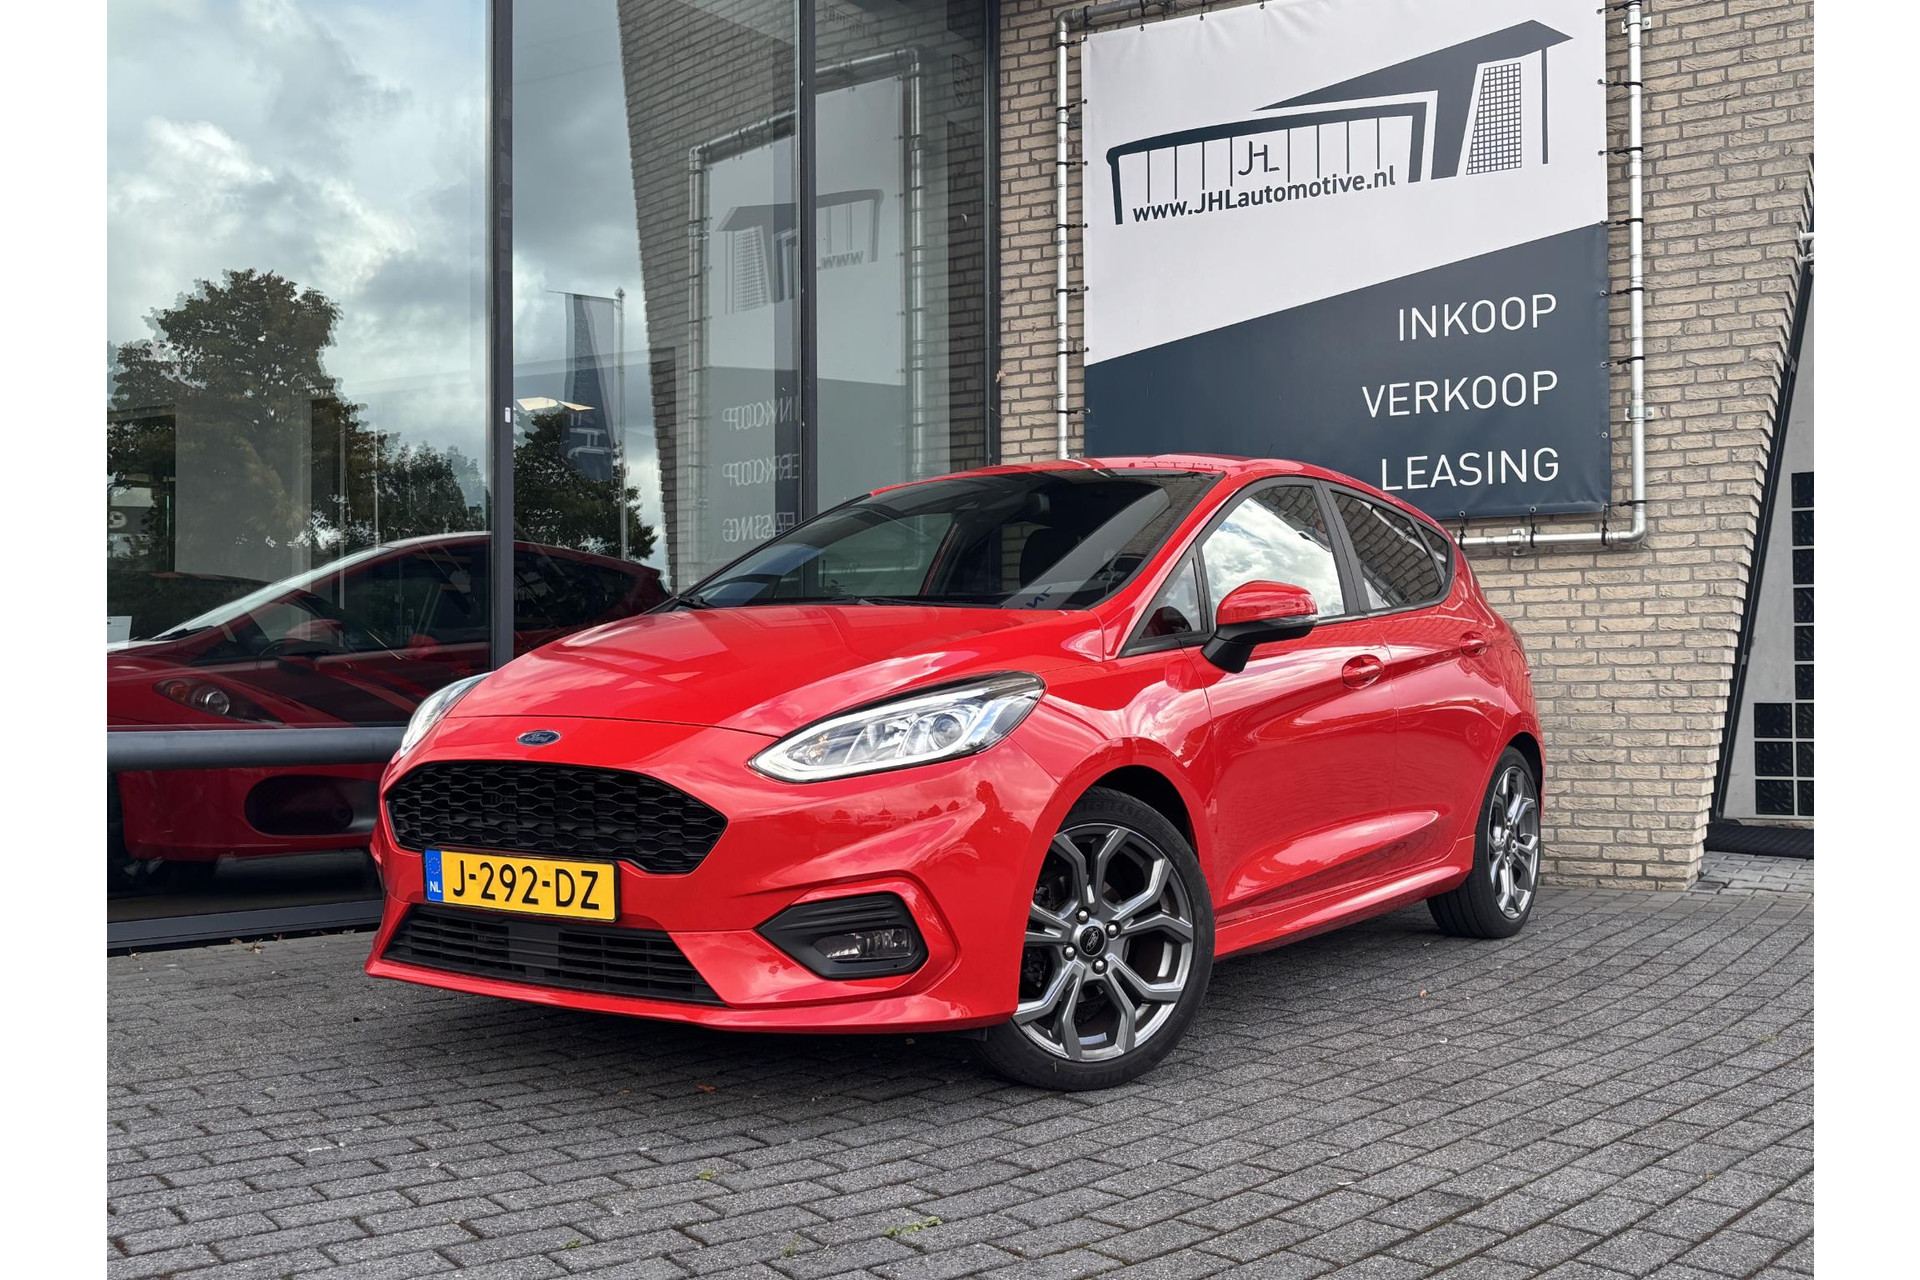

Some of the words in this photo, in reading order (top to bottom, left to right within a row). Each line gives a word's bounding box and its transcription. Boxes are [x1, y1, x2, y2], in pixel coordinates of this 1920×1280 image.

[1238, 141, 1280, 175] JHL
[1133, 166, 1395, 222] www.JHLautomotive.nl
[1399, 293, 1557, 341] INKOOP
[1362, 370, 1558, 418] VERKOOP
[1381, 447, 1559, 491] LEASING
[429, 881, 442, 893] NL
[453, 860, 600, 910] J-292-DZ
